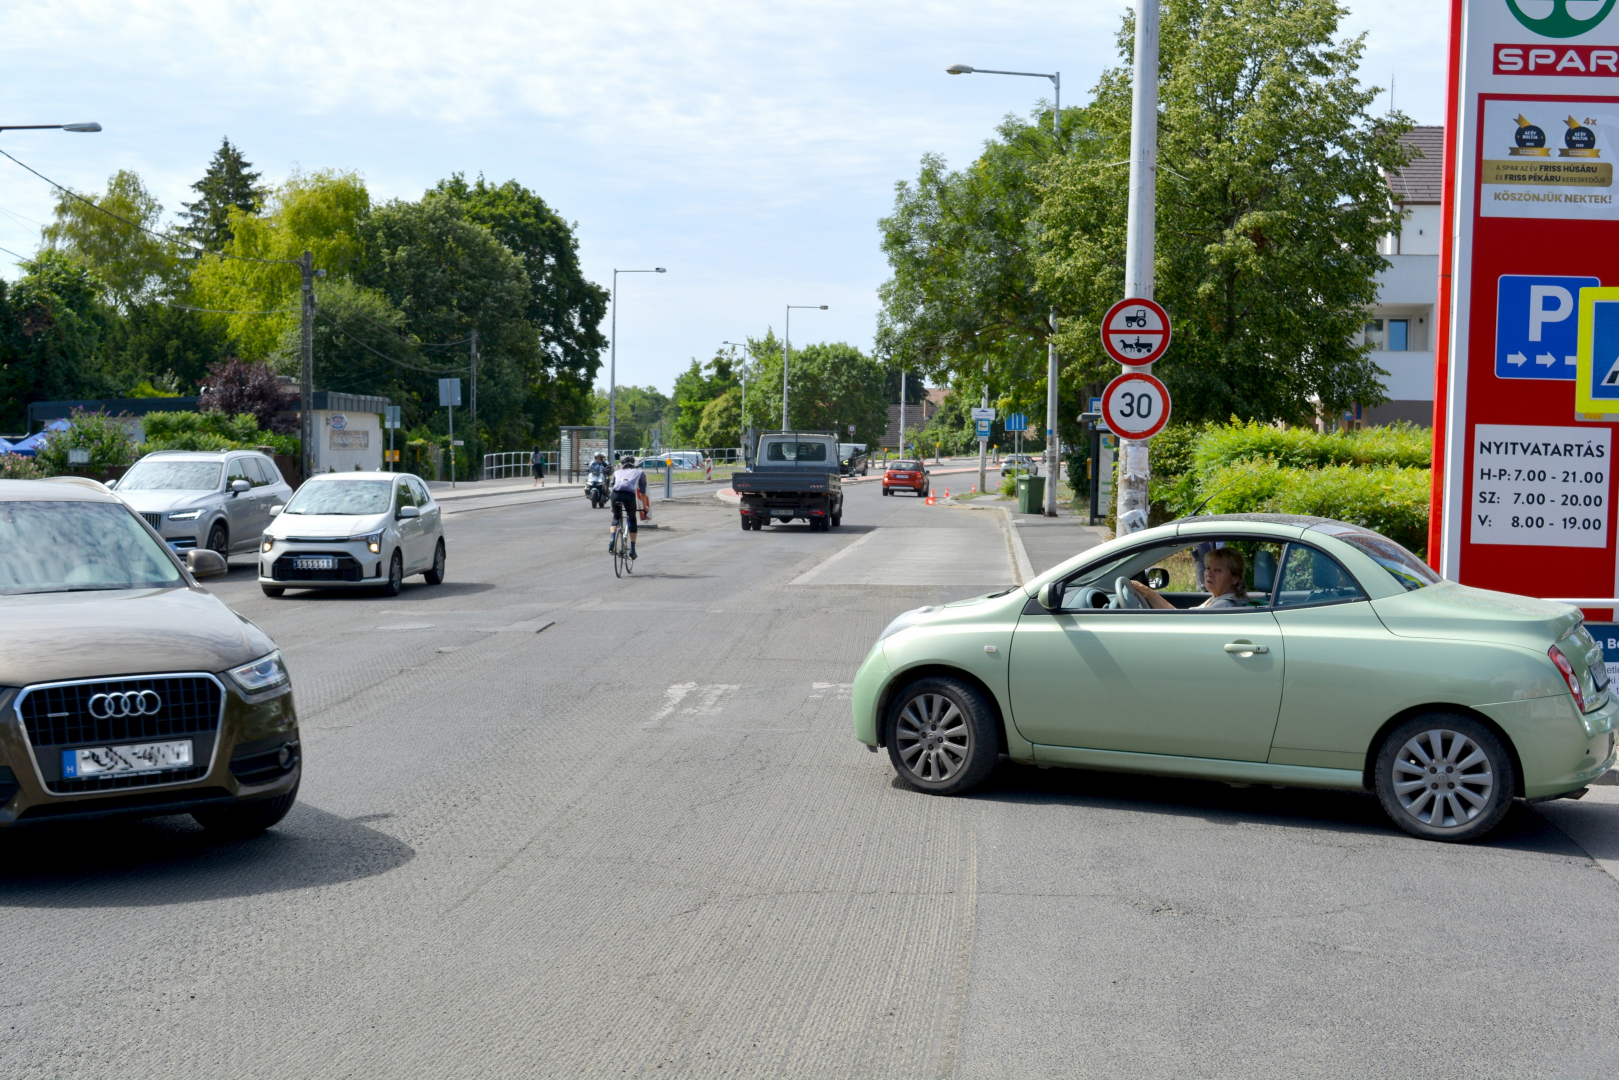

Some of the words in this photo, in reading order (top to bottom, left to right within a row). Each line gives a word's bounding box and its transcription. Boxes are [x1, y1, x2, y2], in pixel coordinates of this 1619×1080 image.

[1498, 48, 1618, 73] SPAR
[1583, 117, 1597, 126] 4x
[1530, 164, 1538, 172] ÉV
[1563, 163, 1597, 173] HÚSÁRU
[1495, 172, 1503, 180] ÉS
[1528, 173, 1561, 182] PÉKÁRU
[1493, 190, 1563, 203] KÖSZÖNJÜK
[1564, 194, 1612, 204] NEKTEK!
[1528, 285, 1574, 342] P
[1120, 392, 1152, 418] 30
[1480, 440, 1605, 458] NYITVATARTÁS
[1514, 469, 1547, 482] 7.00
[1561, 470, 1604, 484] 21.00
[1478, 491, 1500, 504] SZ:
[1513, 493, 1546, 505] 7.00
[1560, 494, 1603, 507] 20.00
[1477, 514, 1492, 527] V:
[1511, 516, 1545, 529] 8.00
[1562, 516, 1602, 530] 19.00
[66, 765, 75, 773] H
